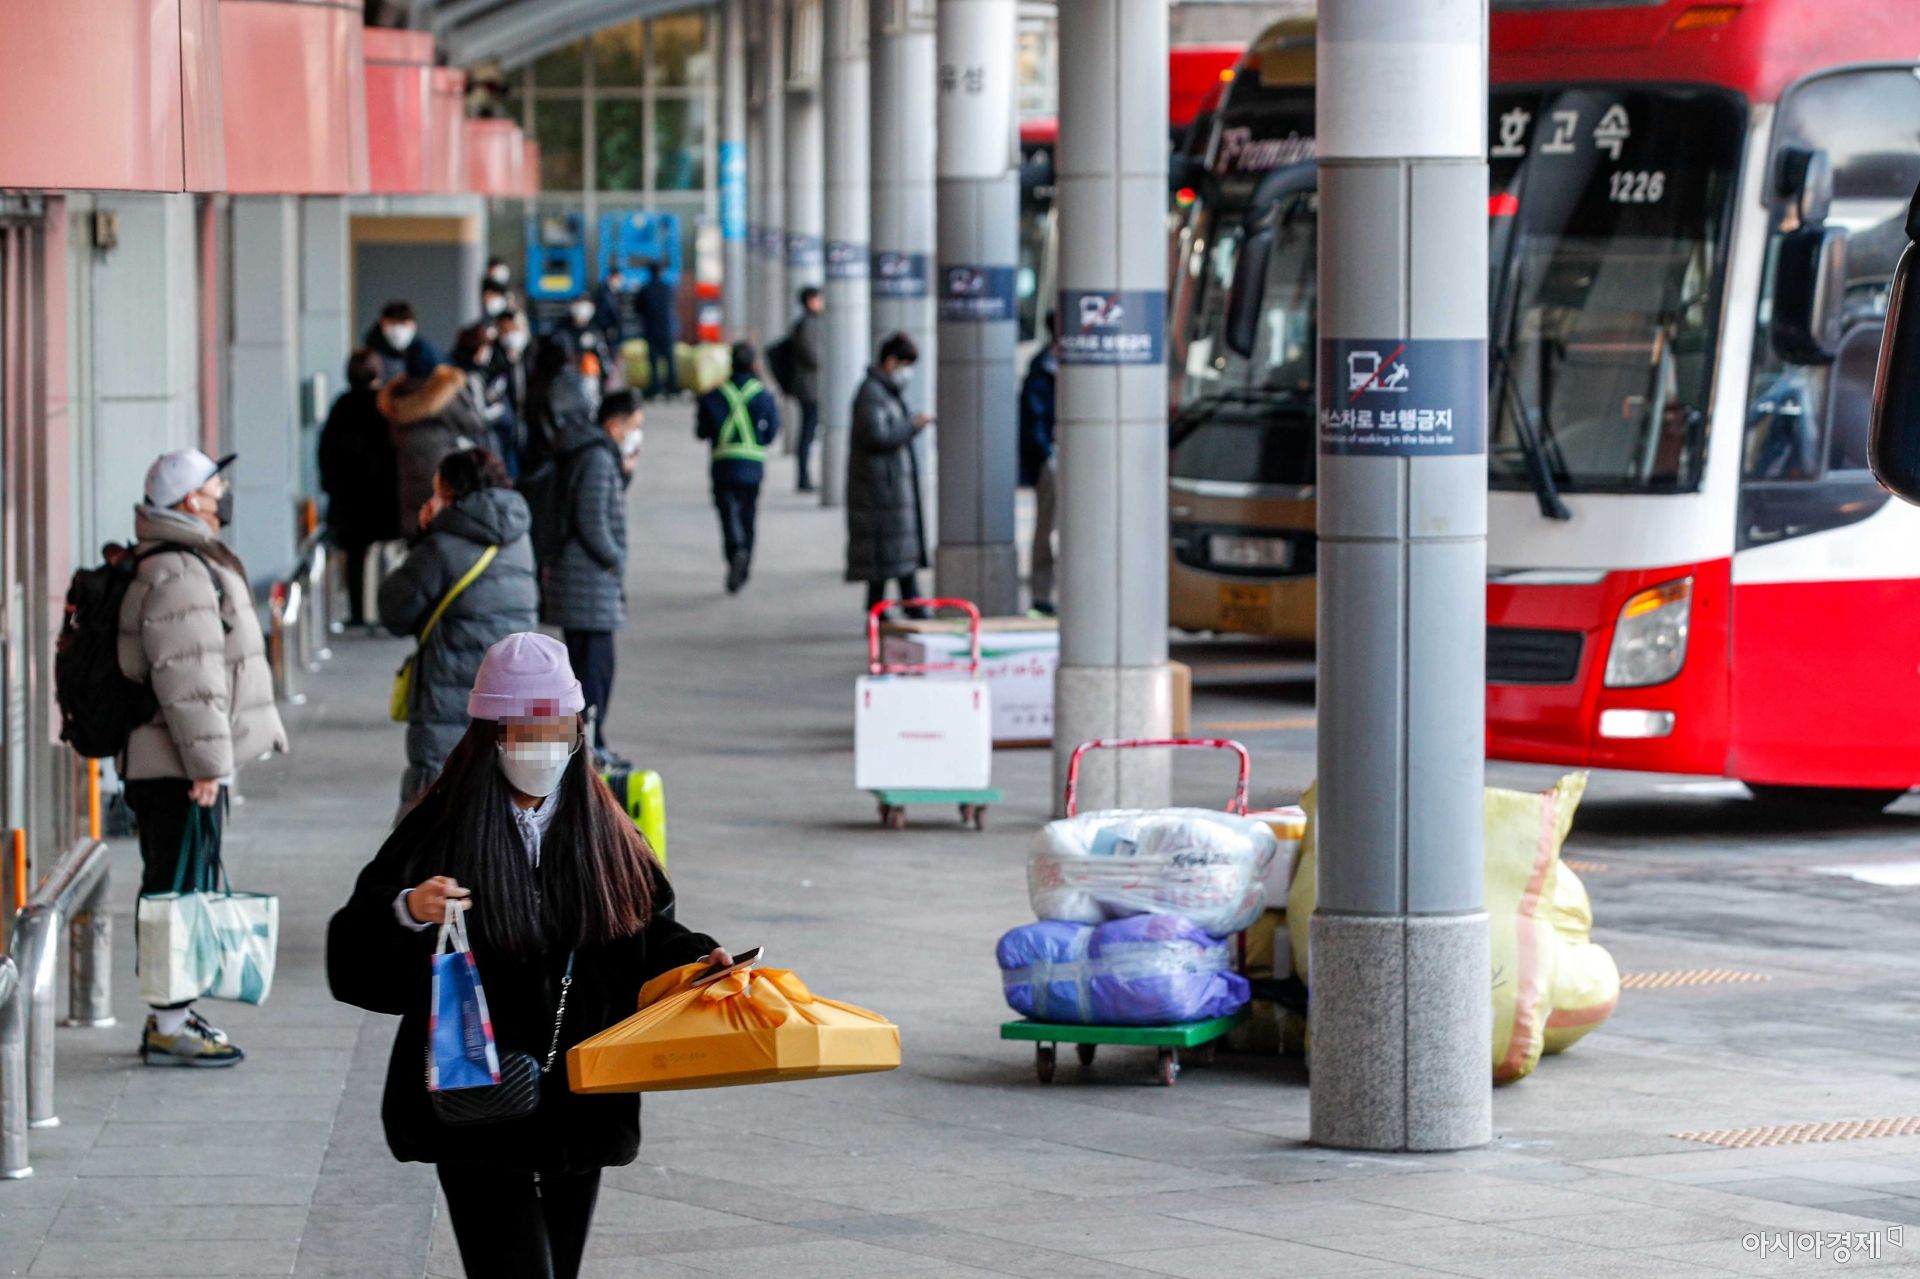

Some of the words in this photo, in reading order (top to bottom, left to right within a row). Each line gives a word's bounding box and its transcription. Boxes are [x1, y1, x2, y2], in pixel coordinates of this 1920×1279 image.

[1609, 170, 1666, 202] 1226
[1378, 408, 1453, 431] 보행금지
[1401, 433, 1418, 445] the
[1418, 433, 1435, 445] bus
